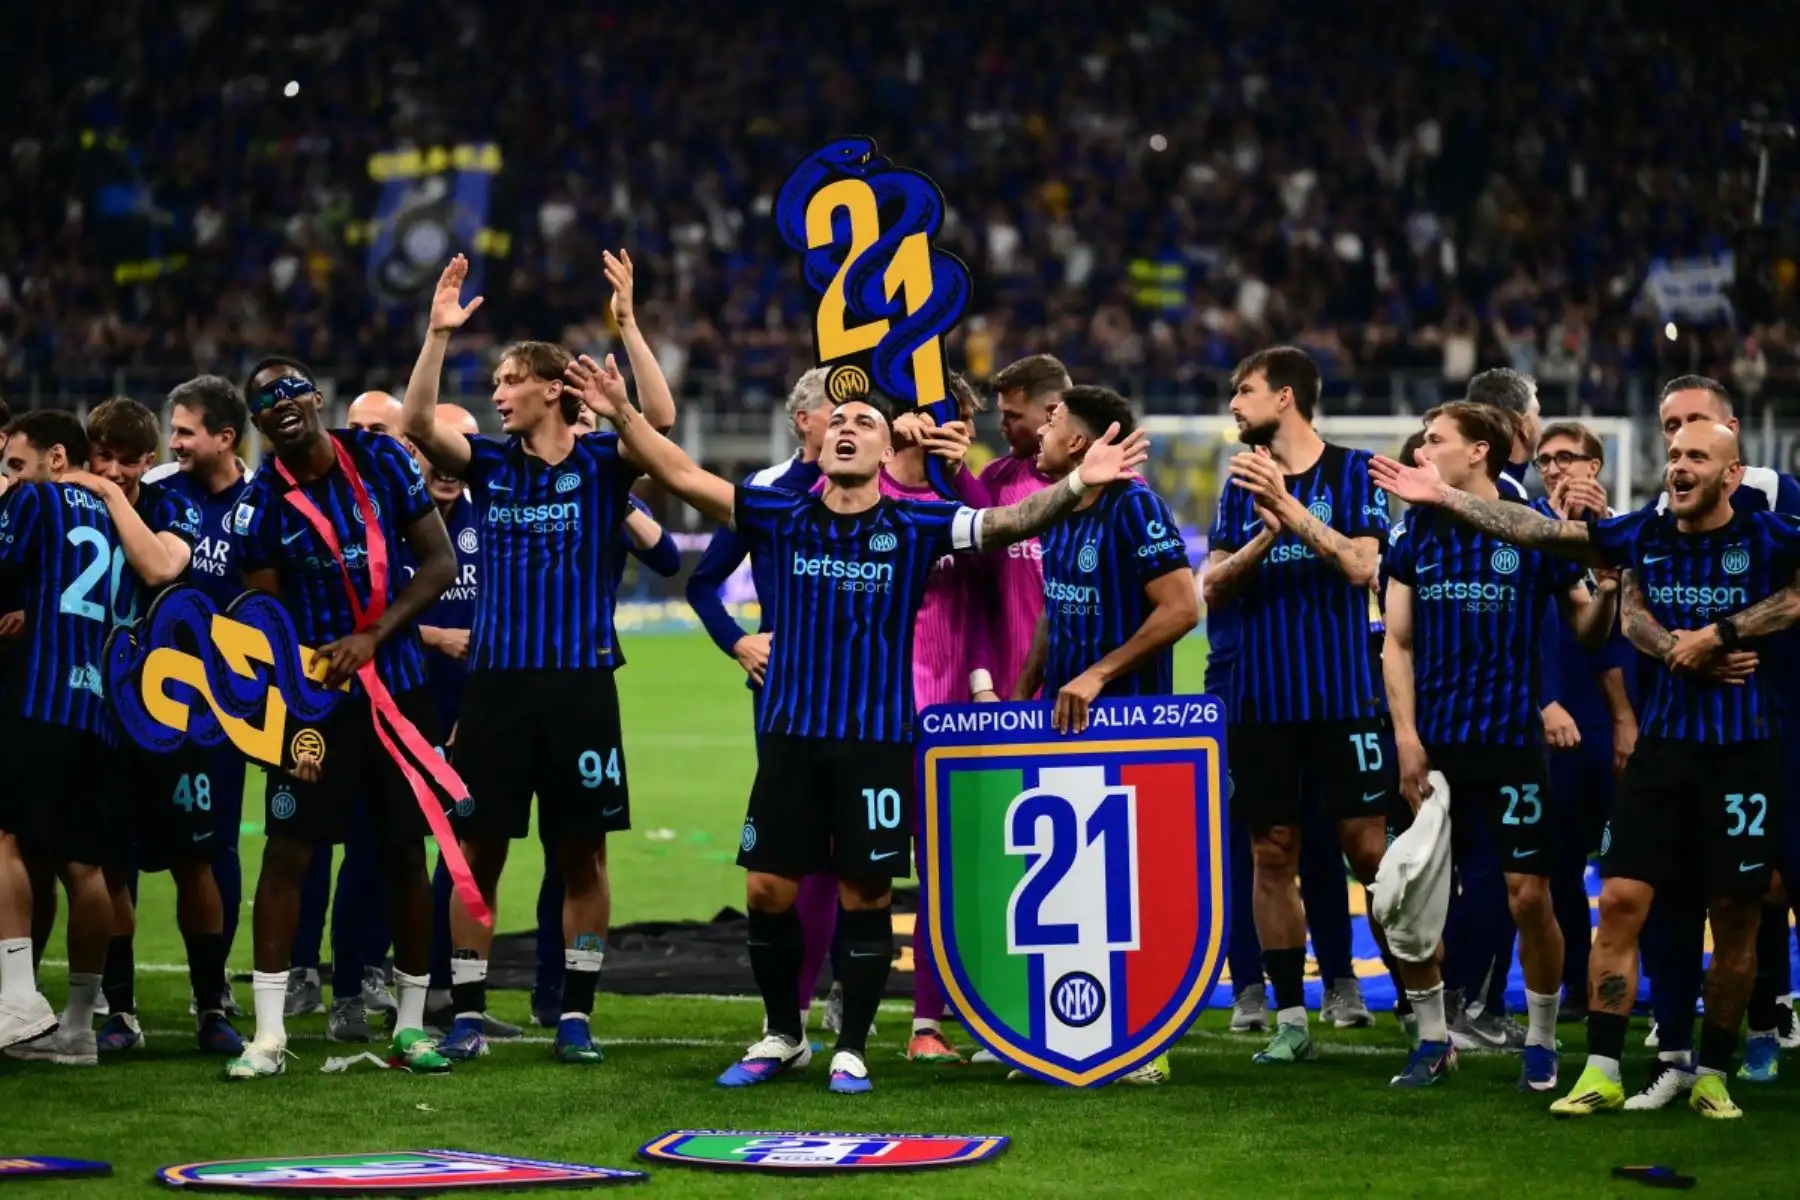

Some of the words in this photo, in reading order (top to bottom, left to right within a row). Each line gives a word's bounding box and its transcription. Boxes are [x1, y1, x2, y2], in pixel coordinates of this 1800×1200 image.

[806, 178, 945, 407] 21
[488, 501, 580, 524] betsson
[793, 552, 893, 581] betsson
[1044, 576, 1100, 603] tsson
[923, 709, 1043, 733] CAMPIONI
[1152, 702, 1218, 727] 25/26
[578, 747, 621, 788] 94
[1350, 733, 1382, 772] 15
[173, 773, 211, 811] 48
[862, 788, 901, 829] 10
[1501, 784, 1542, 825] 23
[1725, 794, 1767, 836] 32
[1009, 789, 1135, 949] 21
